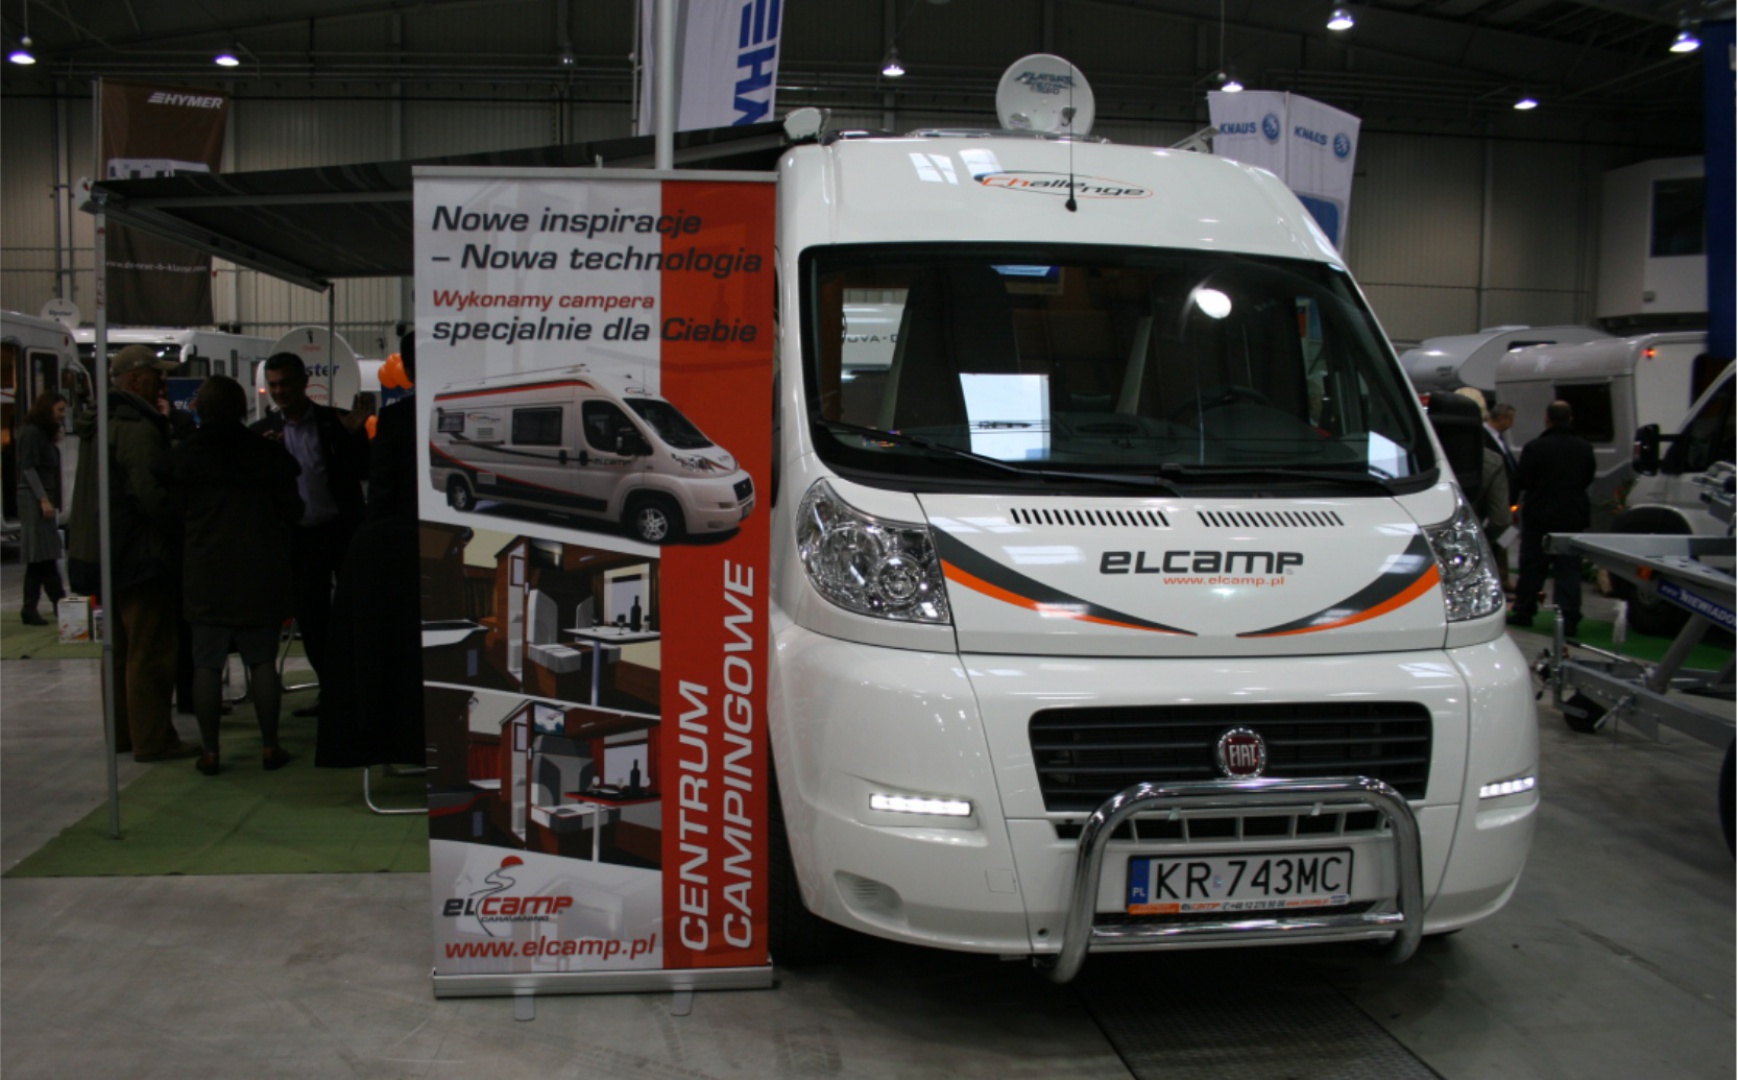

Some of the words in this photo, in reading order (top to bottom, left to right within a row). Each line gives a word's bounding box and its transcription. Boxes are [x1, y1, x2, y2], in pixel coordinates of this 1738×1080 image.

[163, 92, 224, 109] HYMER
[1219, 122, 1257, 134] KNAUS
[981, 177, 1145, 197] Challenge
[432, 206, 529, 231] Nowe
[540, 208, 703, 239] inspiracje
[460, 244, 557, 270] Nowa
[569, 246, 762, 279] technologia
[433, 290, 553, 311] Wykonamy
[558, 293, 655, 312] campera
[432, 317, 592, 346] specjalnie
[602, 317, 651, 341] dla
[661, 317, 757, 342] Ciebie
[305, 364, 341, 377] ster
[1163, 575, 1285, 587] www.elcamp.pl
[1680, 589, 1736, 628] NIEWIADO
[723, 559, 755, 949] CAMPINGOWE
[1228, 743, 1257, 767] FIAT
[679, 680, 709, 951] CENTRUM
[1132, 886, 1147, 897] PL
[1155, 862, 1213, 900] KR
[1226, 856, 1343, 897] 743MC
[444, 934, 656, 960] www.elcamp.pl
